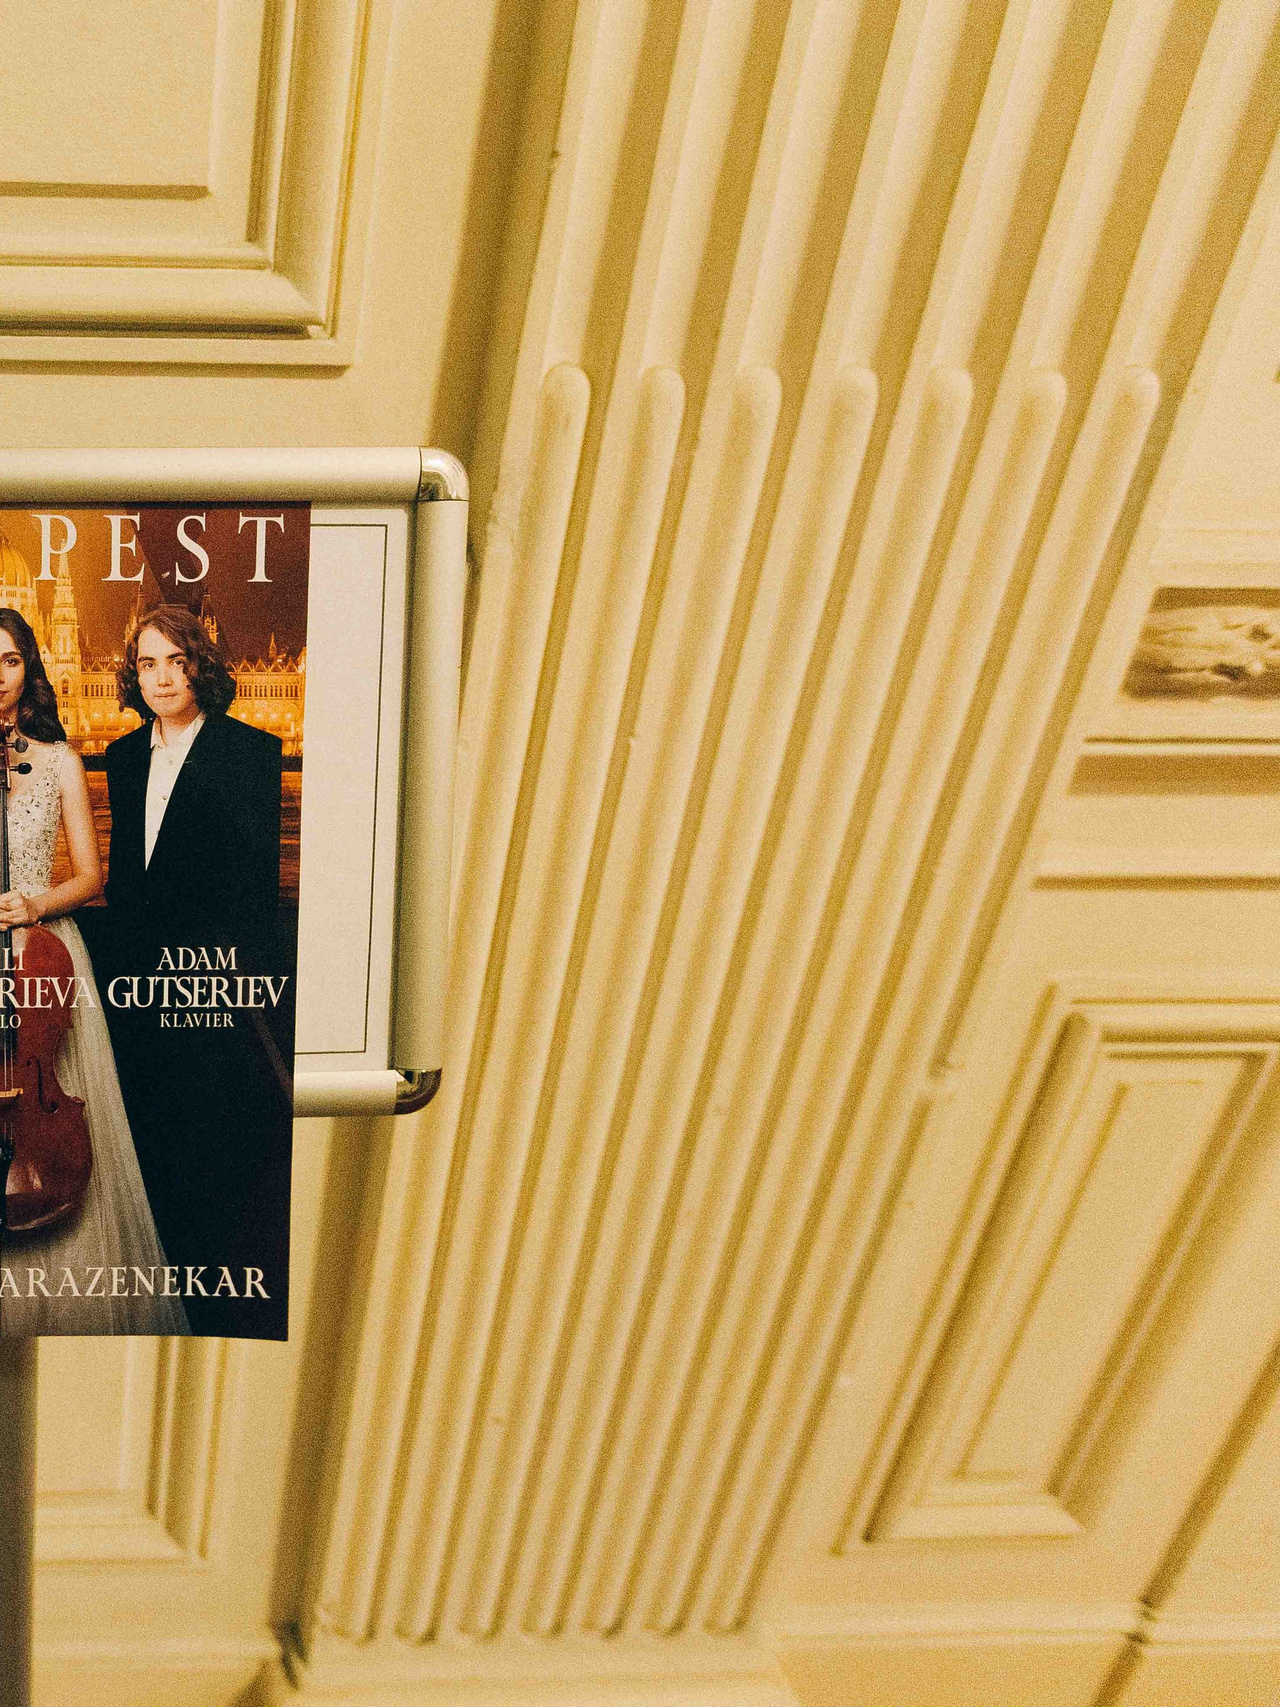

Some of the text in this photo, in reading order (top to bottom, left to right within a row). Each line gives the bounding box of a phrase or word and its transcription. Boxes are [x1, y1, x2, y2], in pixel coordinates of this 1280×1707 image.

[156, 946, 238, 971] ADAM
[107, 975, 289, 1010] GUTSERIEV
[160, 1013, 234, 1028] KLAVIER
